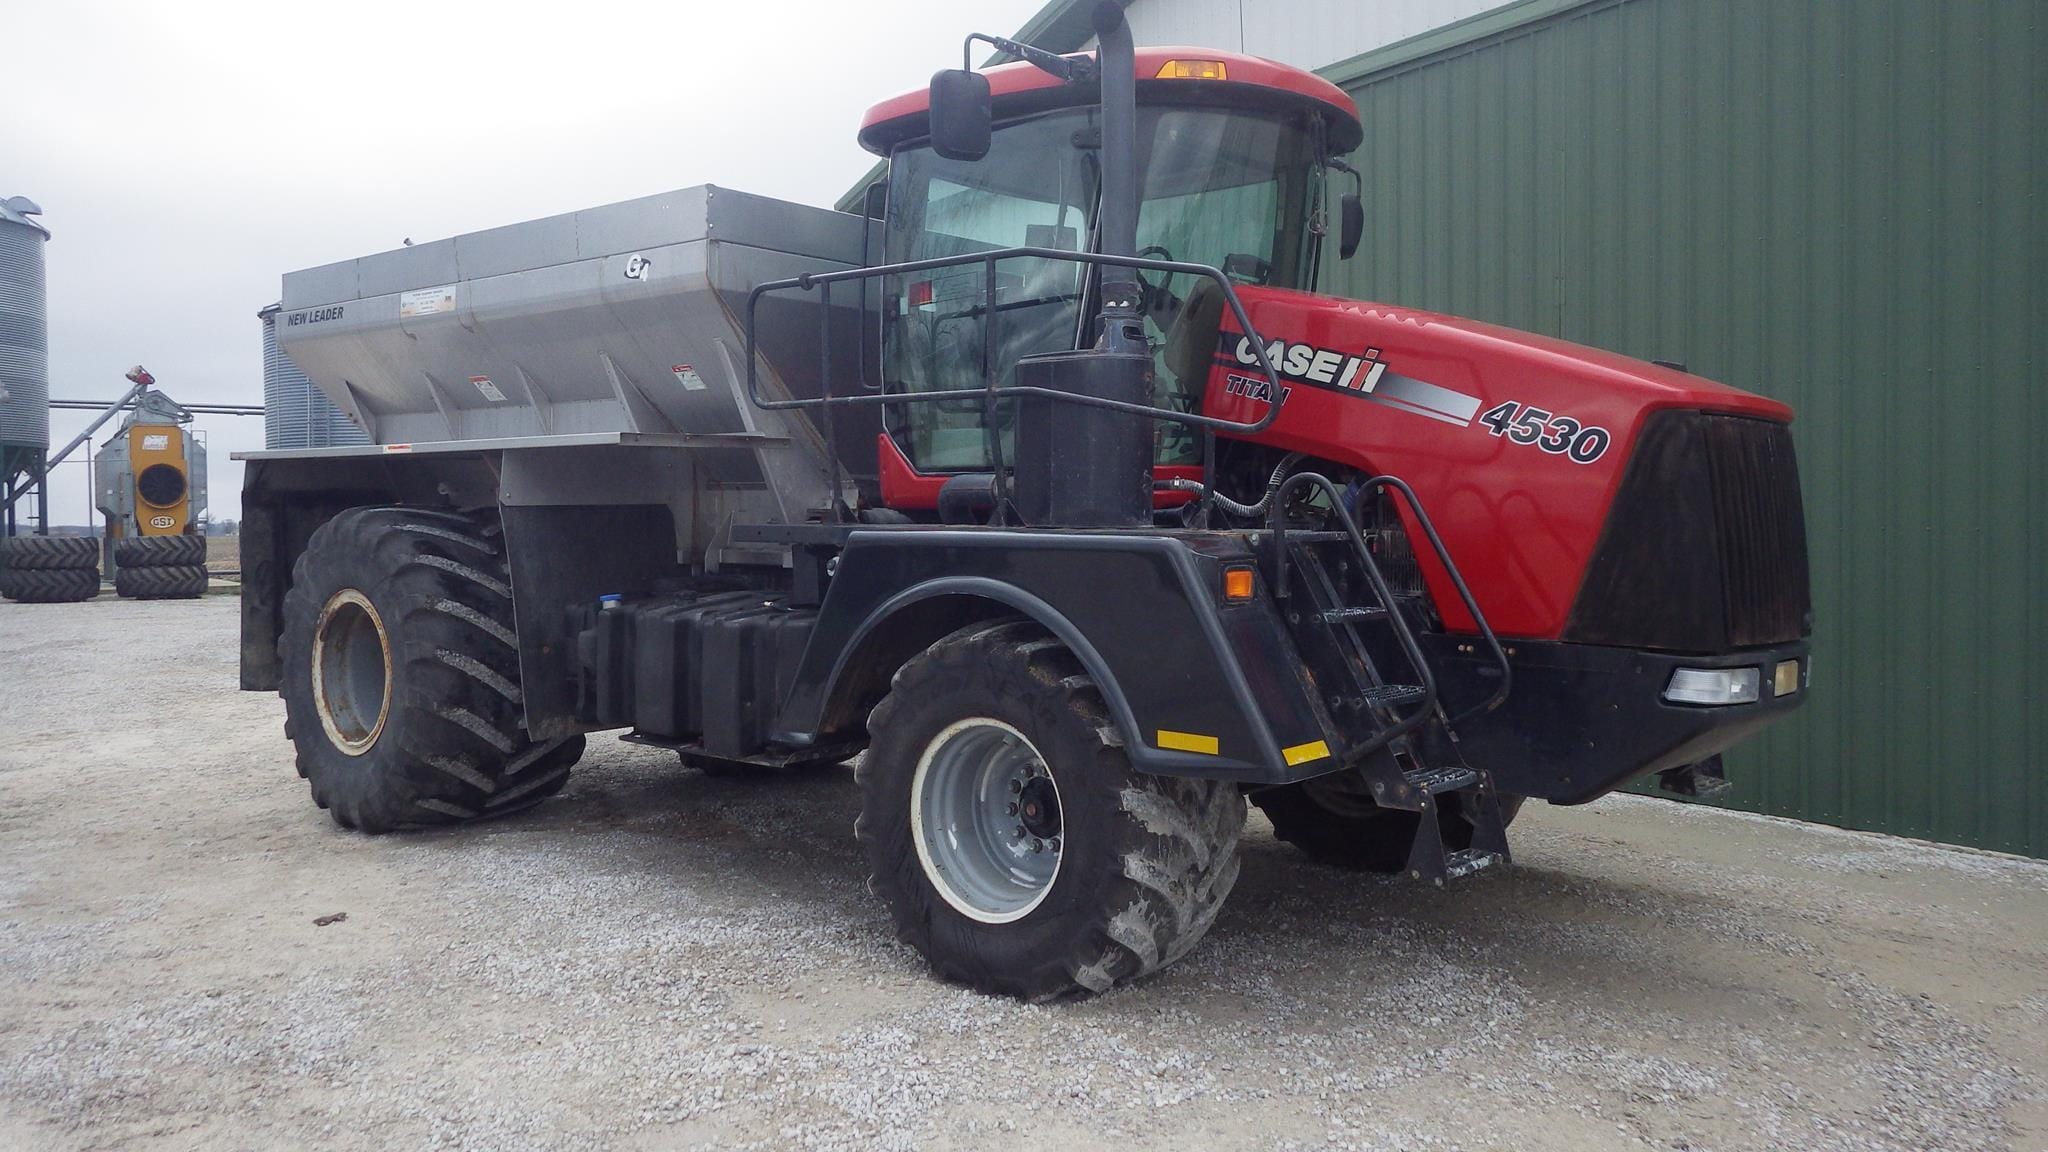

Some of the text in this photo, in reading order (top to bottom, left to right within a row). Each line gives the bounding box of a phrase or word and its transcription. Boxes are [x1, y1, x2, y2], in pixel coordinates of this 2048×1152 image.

[288, 306, 344, 327] NEW LEADER
[1236, 336, 1343, 383] CASE
[1478, 400, 1611, 465] 4530
[153, 517, 172, 526] GSI
